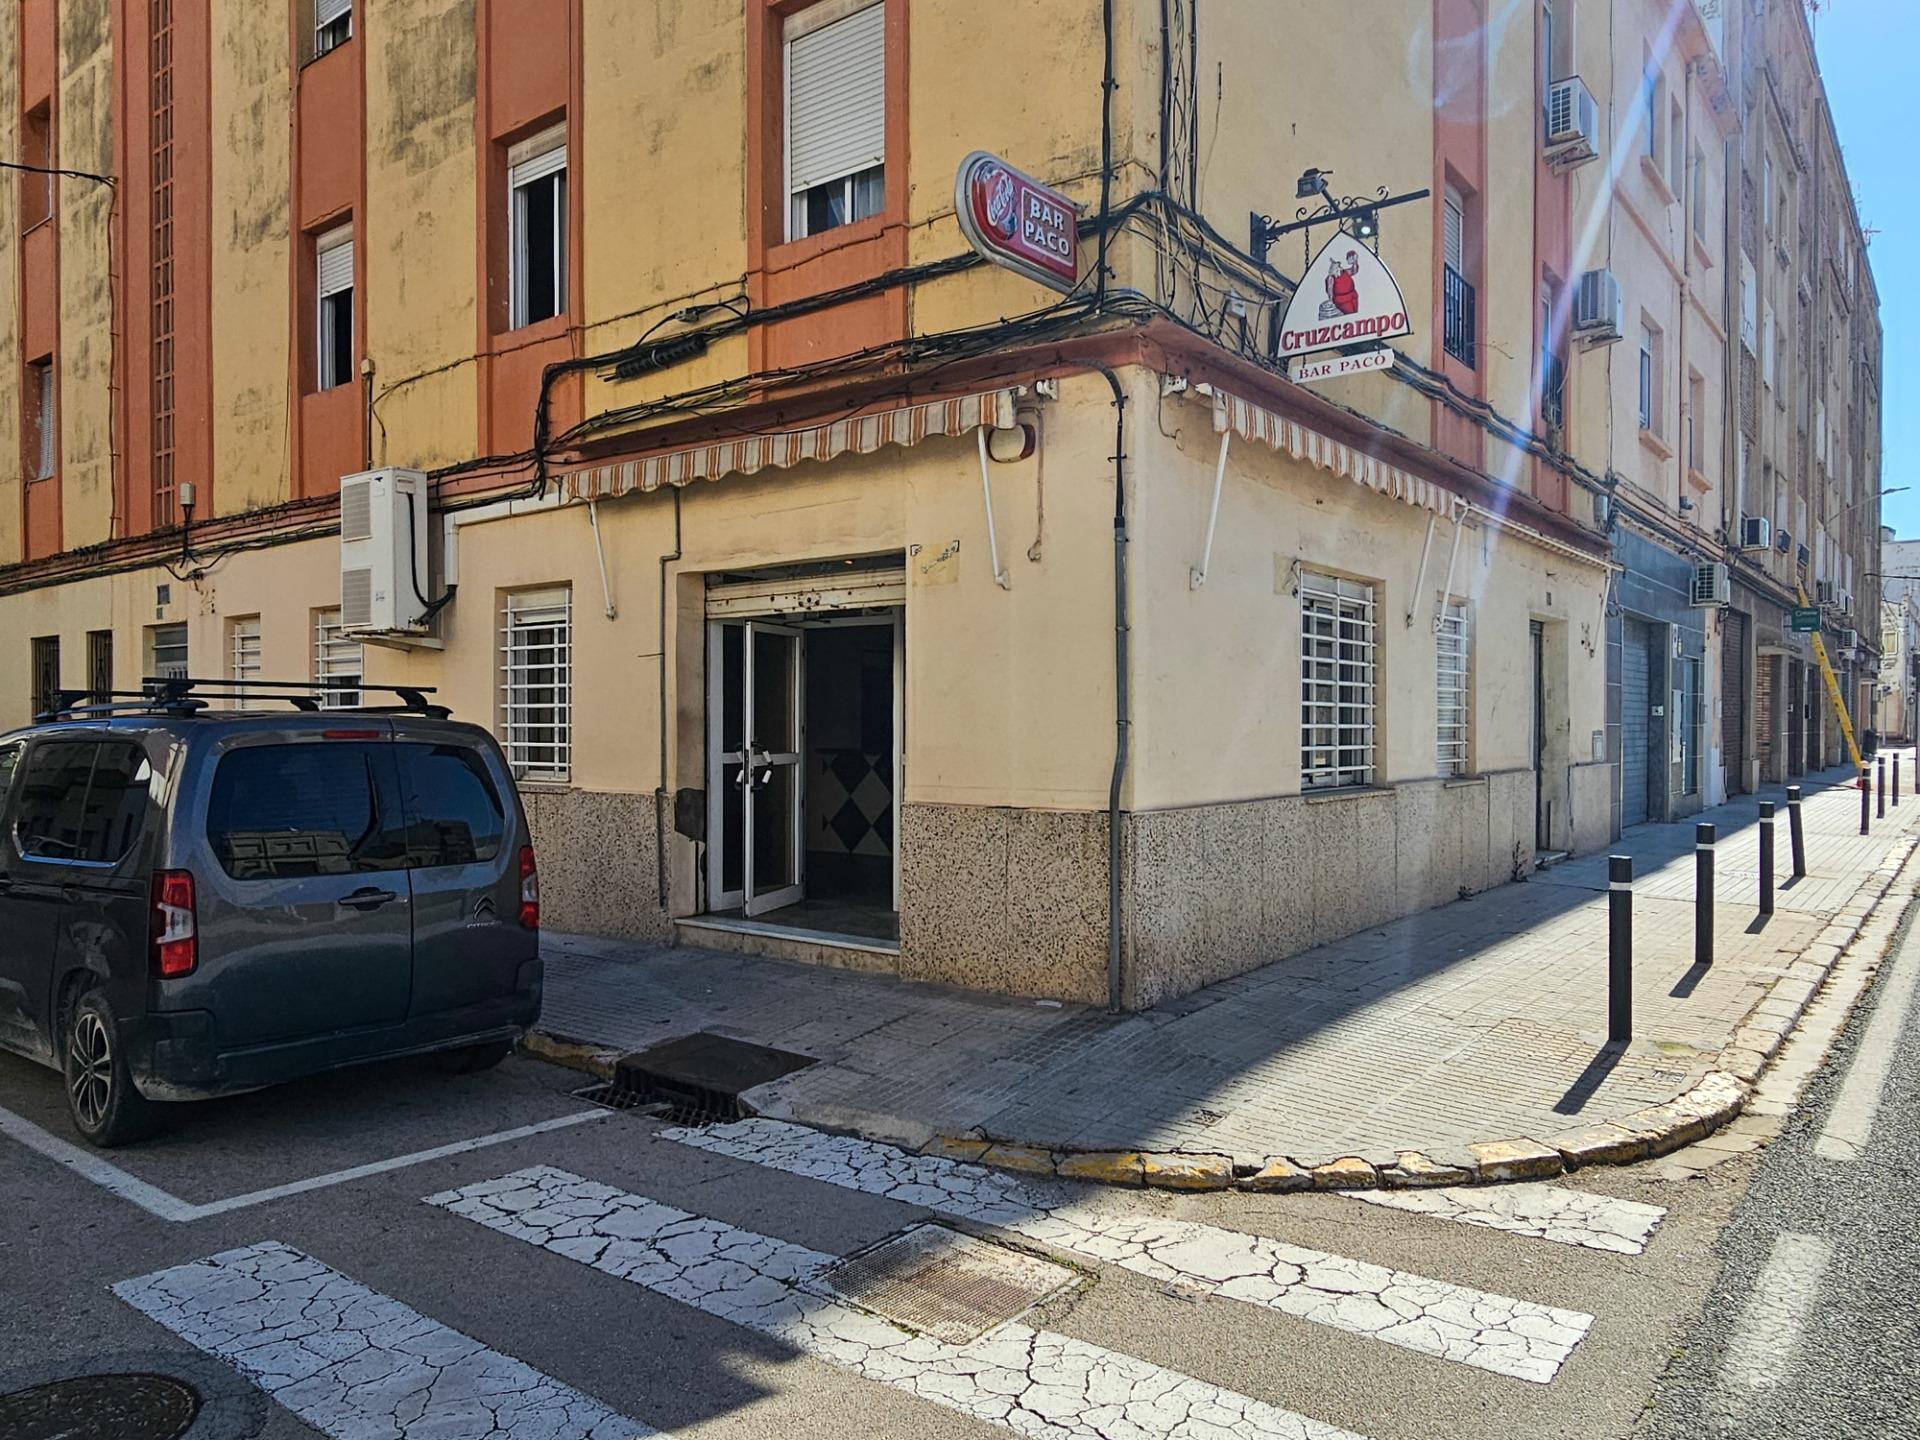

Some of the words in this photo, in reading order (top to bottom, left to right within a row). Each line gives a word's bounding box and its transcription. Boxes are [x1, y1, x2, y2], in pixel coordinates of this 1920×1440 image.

[1030, 197, 1064, 231] BAR
[1025, 220, 1070, 256] PACO
[1281, 312, 1405, 351] Cruzcampo
[1299, 364, 1331, 379] BAR
[1339, 355, 1386, 372] PACO
